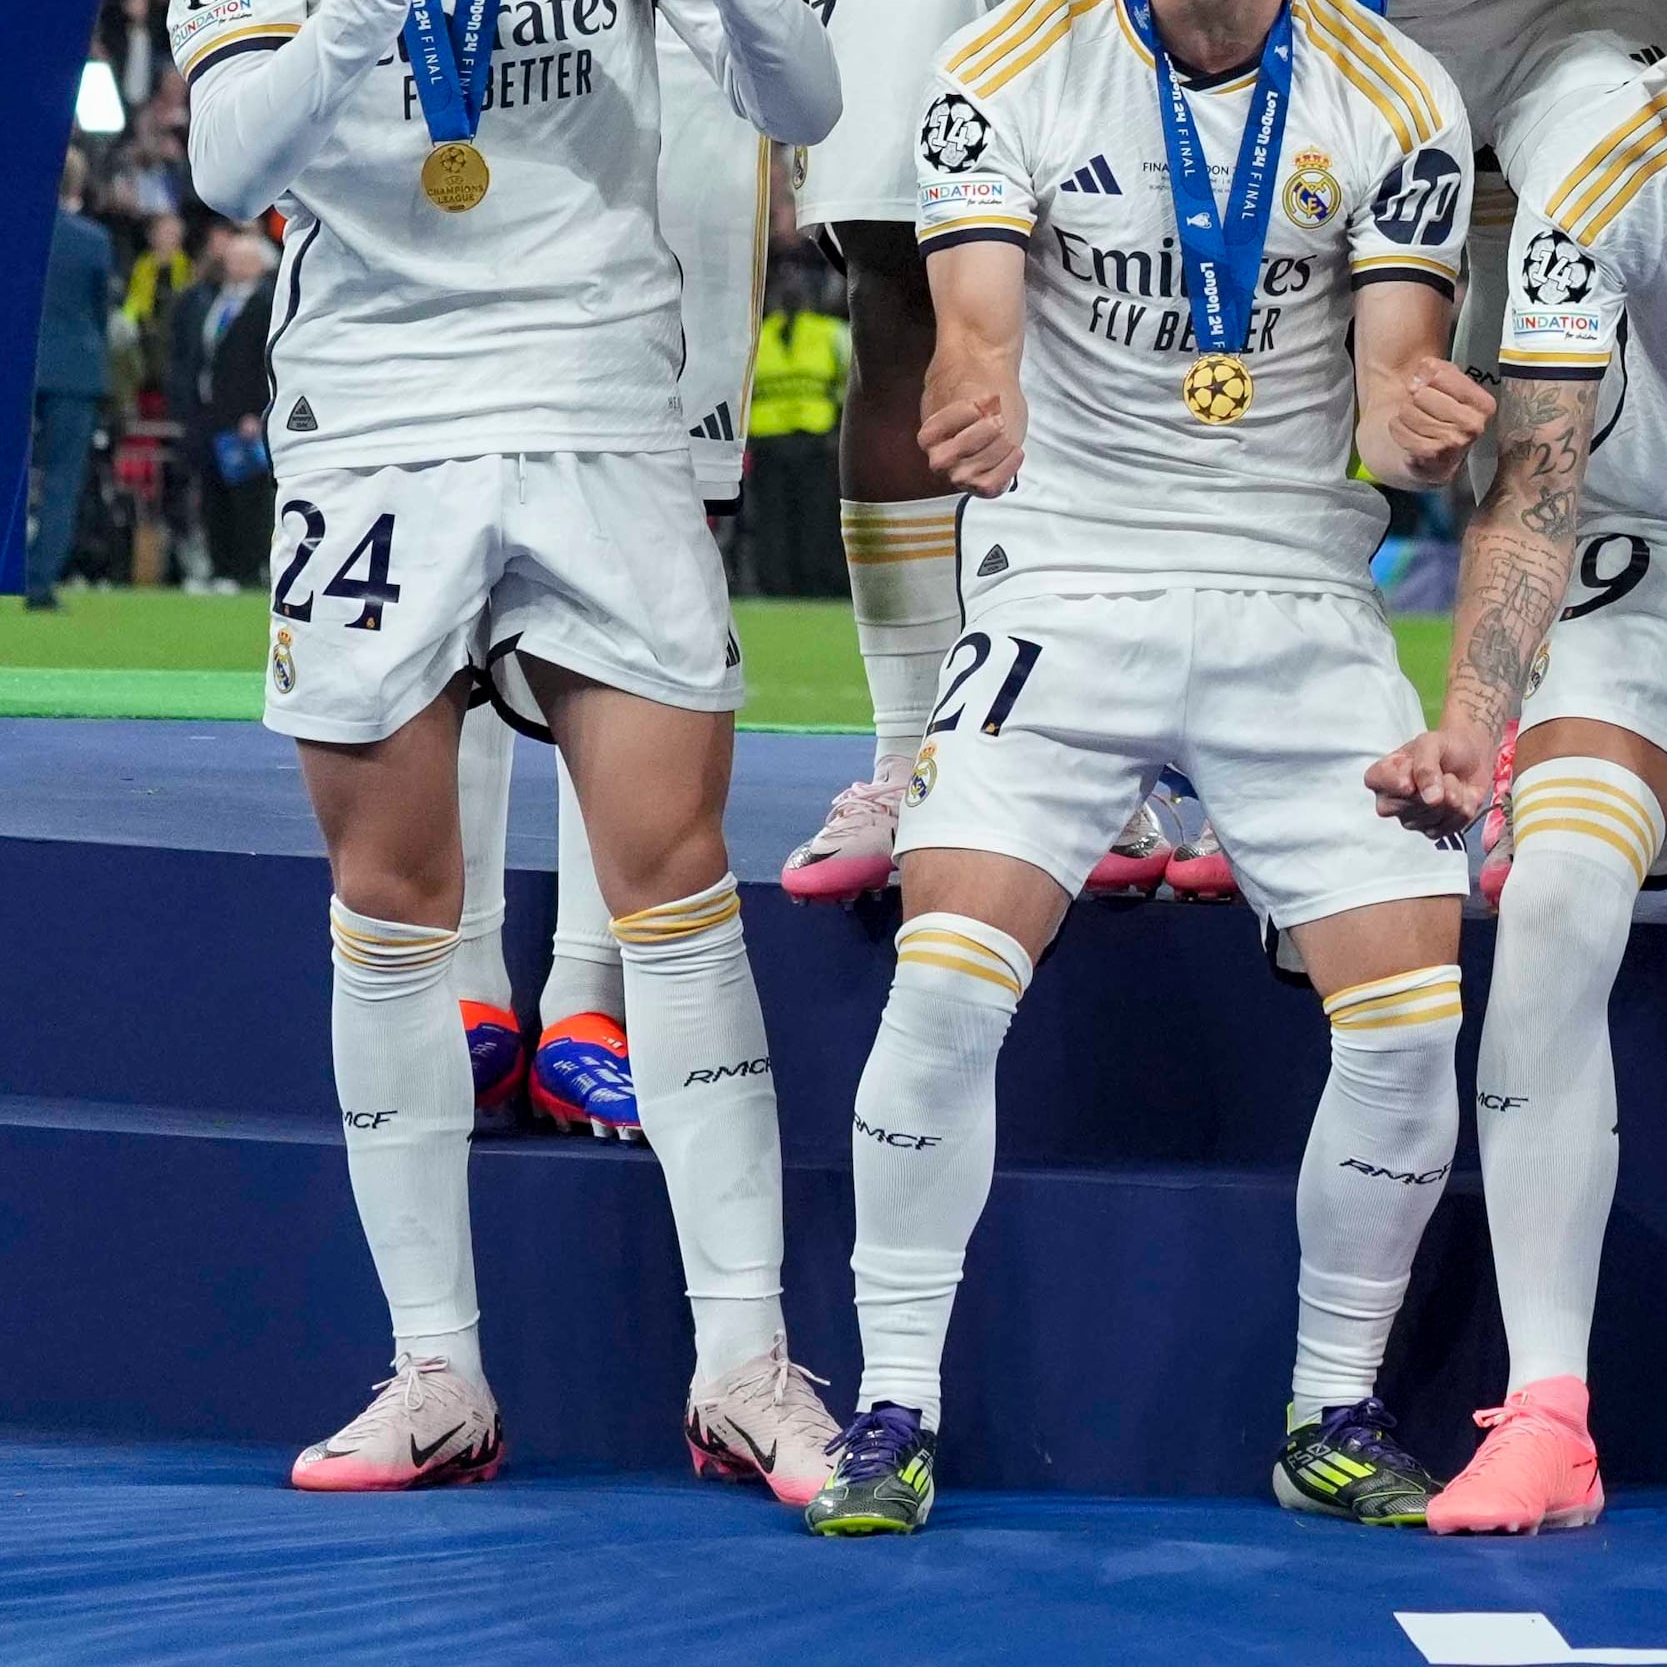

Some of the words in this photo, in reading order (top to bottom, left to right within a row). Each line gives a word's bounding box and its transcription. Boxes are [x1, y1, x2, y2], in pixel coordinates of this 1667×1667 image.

[415, 11, 431, 30] 24
[423, 37, 443, 84] FINAL
[483, 49, 593, 111] BETTER
[935, 115, 969, 153] 14
[1253, 147, 1266, 167] 24
[922, 184, 1003, 204] UNDATION
[1242, 172, 1262, 219] FINAL
[1371, 148, 1462, 246] hp
[1533, 251, 1576, 290] 14
[1090, 296, 1145, 341] FLY
[1154, 311, 1284, 354] BEER
[1533, 434, 1576, 476] 23
[275, 500, 400, 630] 24
[928, 632, 1042, 737] 21
